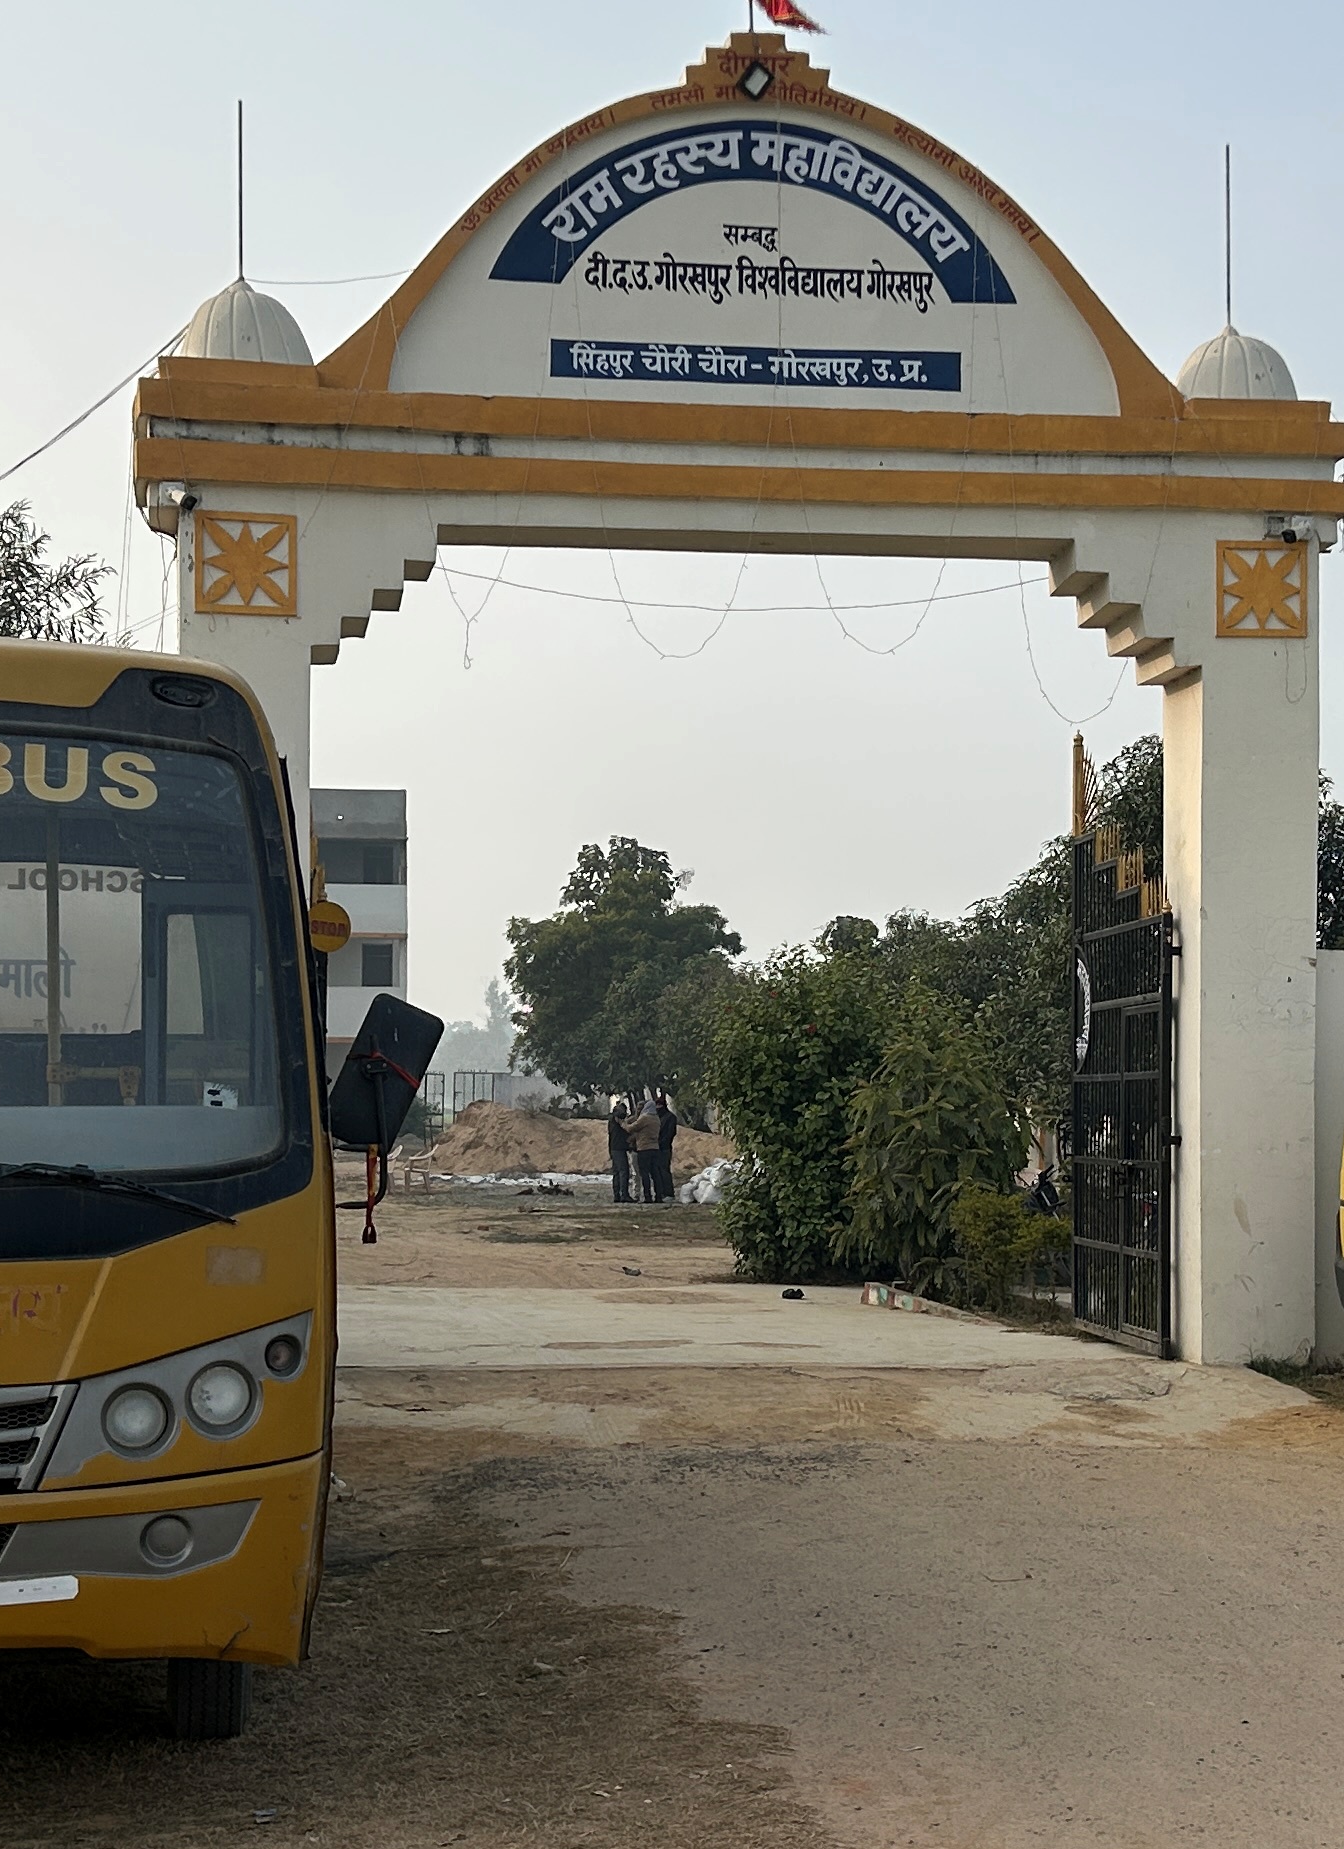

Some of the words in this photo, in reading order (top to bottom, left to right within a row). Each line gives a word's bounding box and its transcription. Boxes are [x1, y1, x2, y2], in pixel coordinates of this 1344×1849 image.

[541, 168, 624, 243] राम
[614, 130, 744, 194] रहस्य
[750, 130, 971, 264] महाविद्यालय
[654, 251, 733, 305] गोरखपुर
[736, 256, 865, 303] विश्वविद्यालय
[867, 258, 936, 314] गोरखपुर
[568, 342, 635, 378] सिंहपुर
